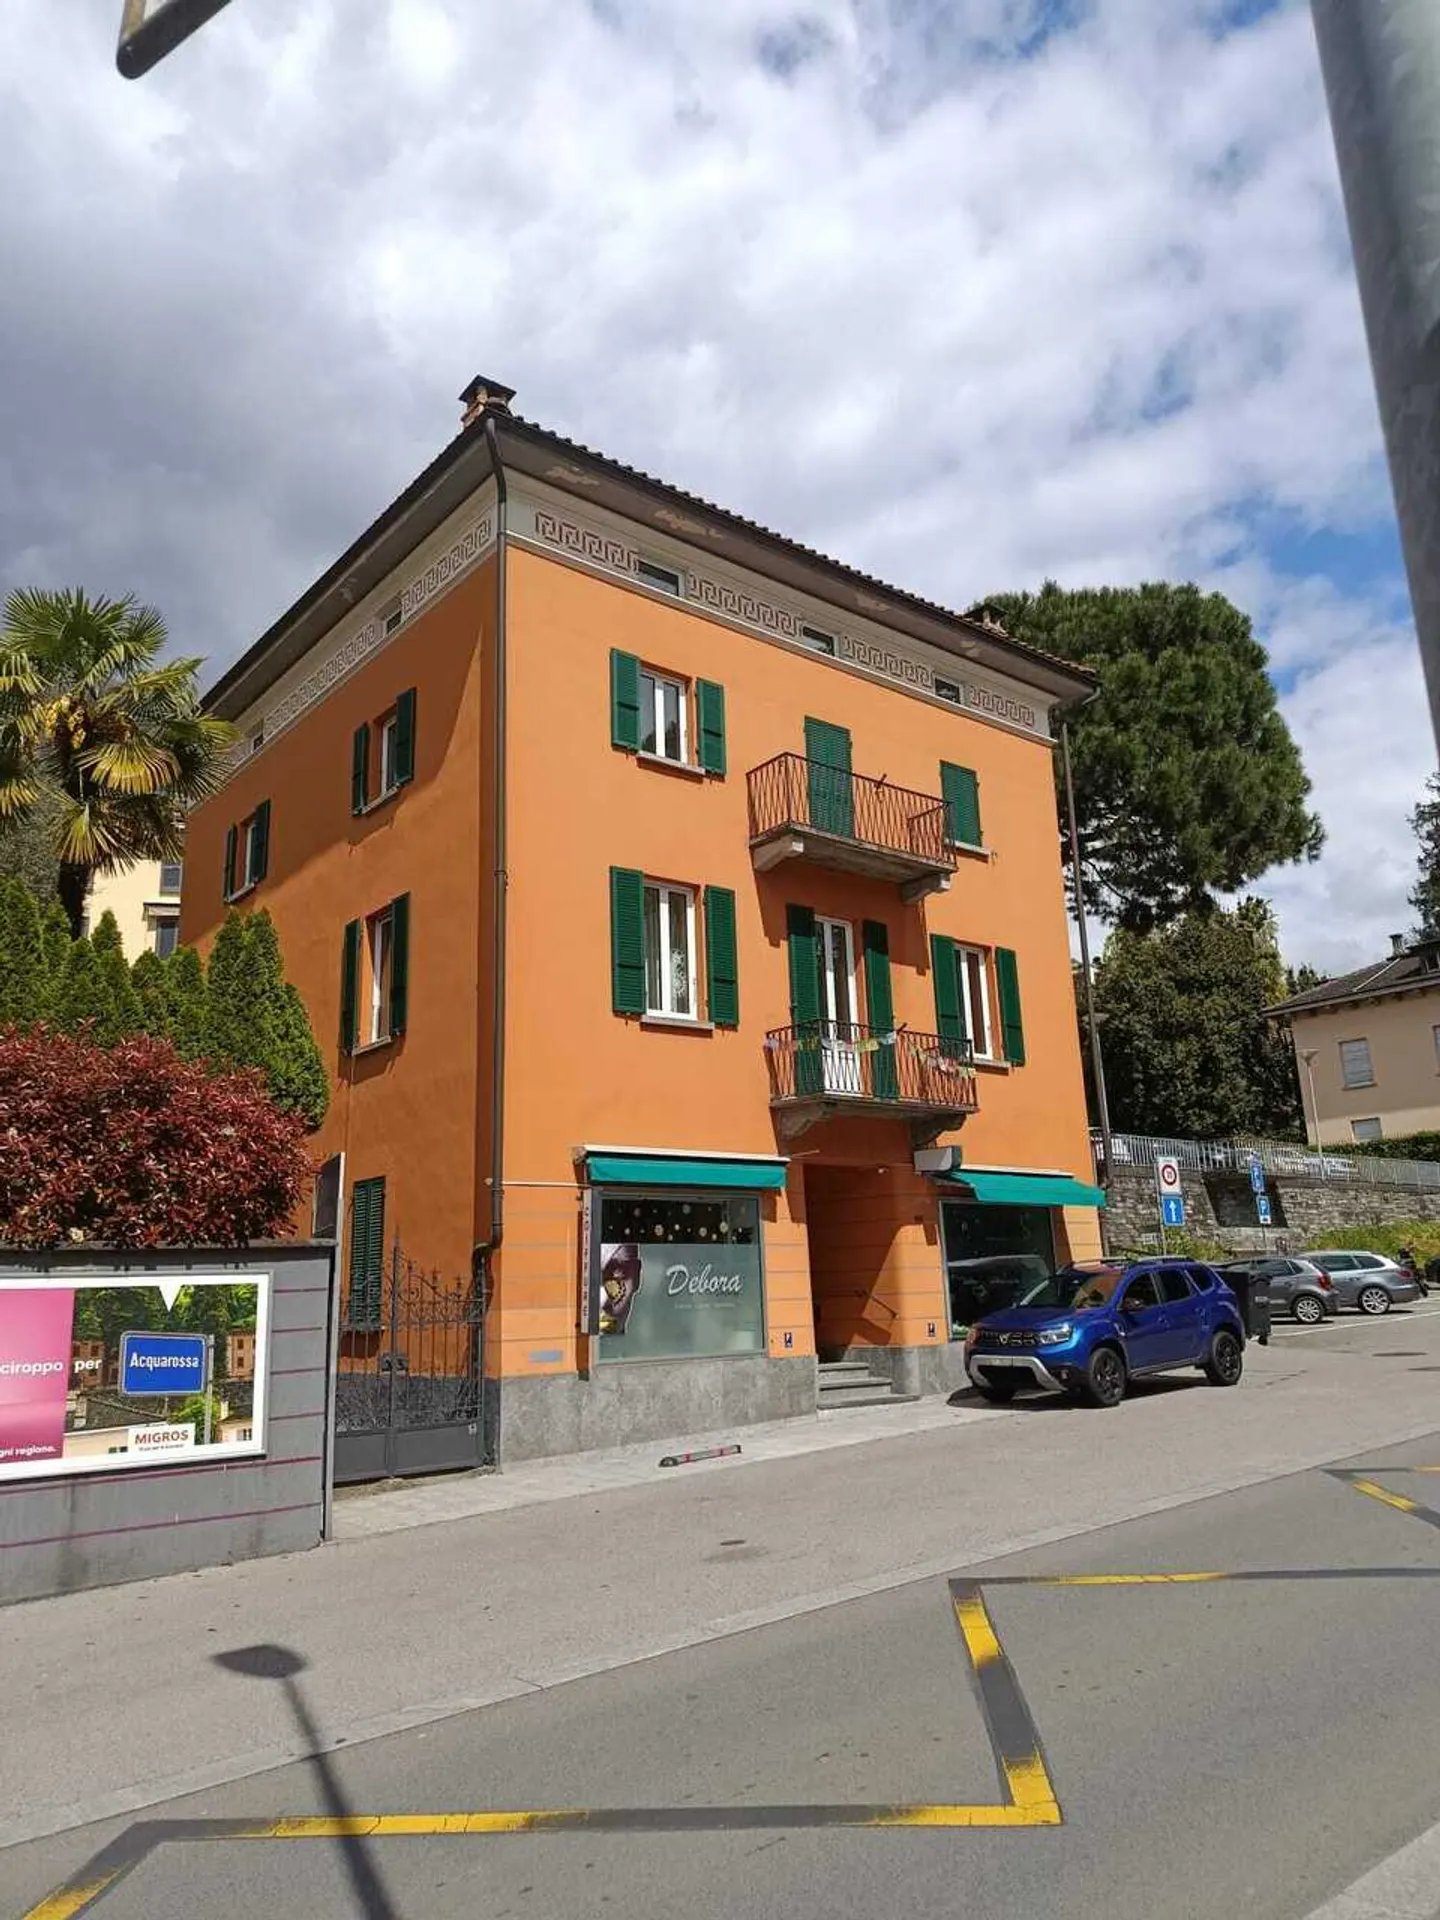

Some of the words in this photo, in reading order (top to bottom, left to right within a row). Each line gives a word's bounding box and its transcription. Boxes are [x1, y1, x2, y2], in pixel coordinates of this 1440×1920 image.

[666, 1264, 744, 1294] Debora
[0, 1361, 63, 1376] ciroppo
[74, 1359, 102, 1373] per
[129, 1352, 200, 1371] Acquarossa
[135, 1430, 189, 1444] MIGROS
